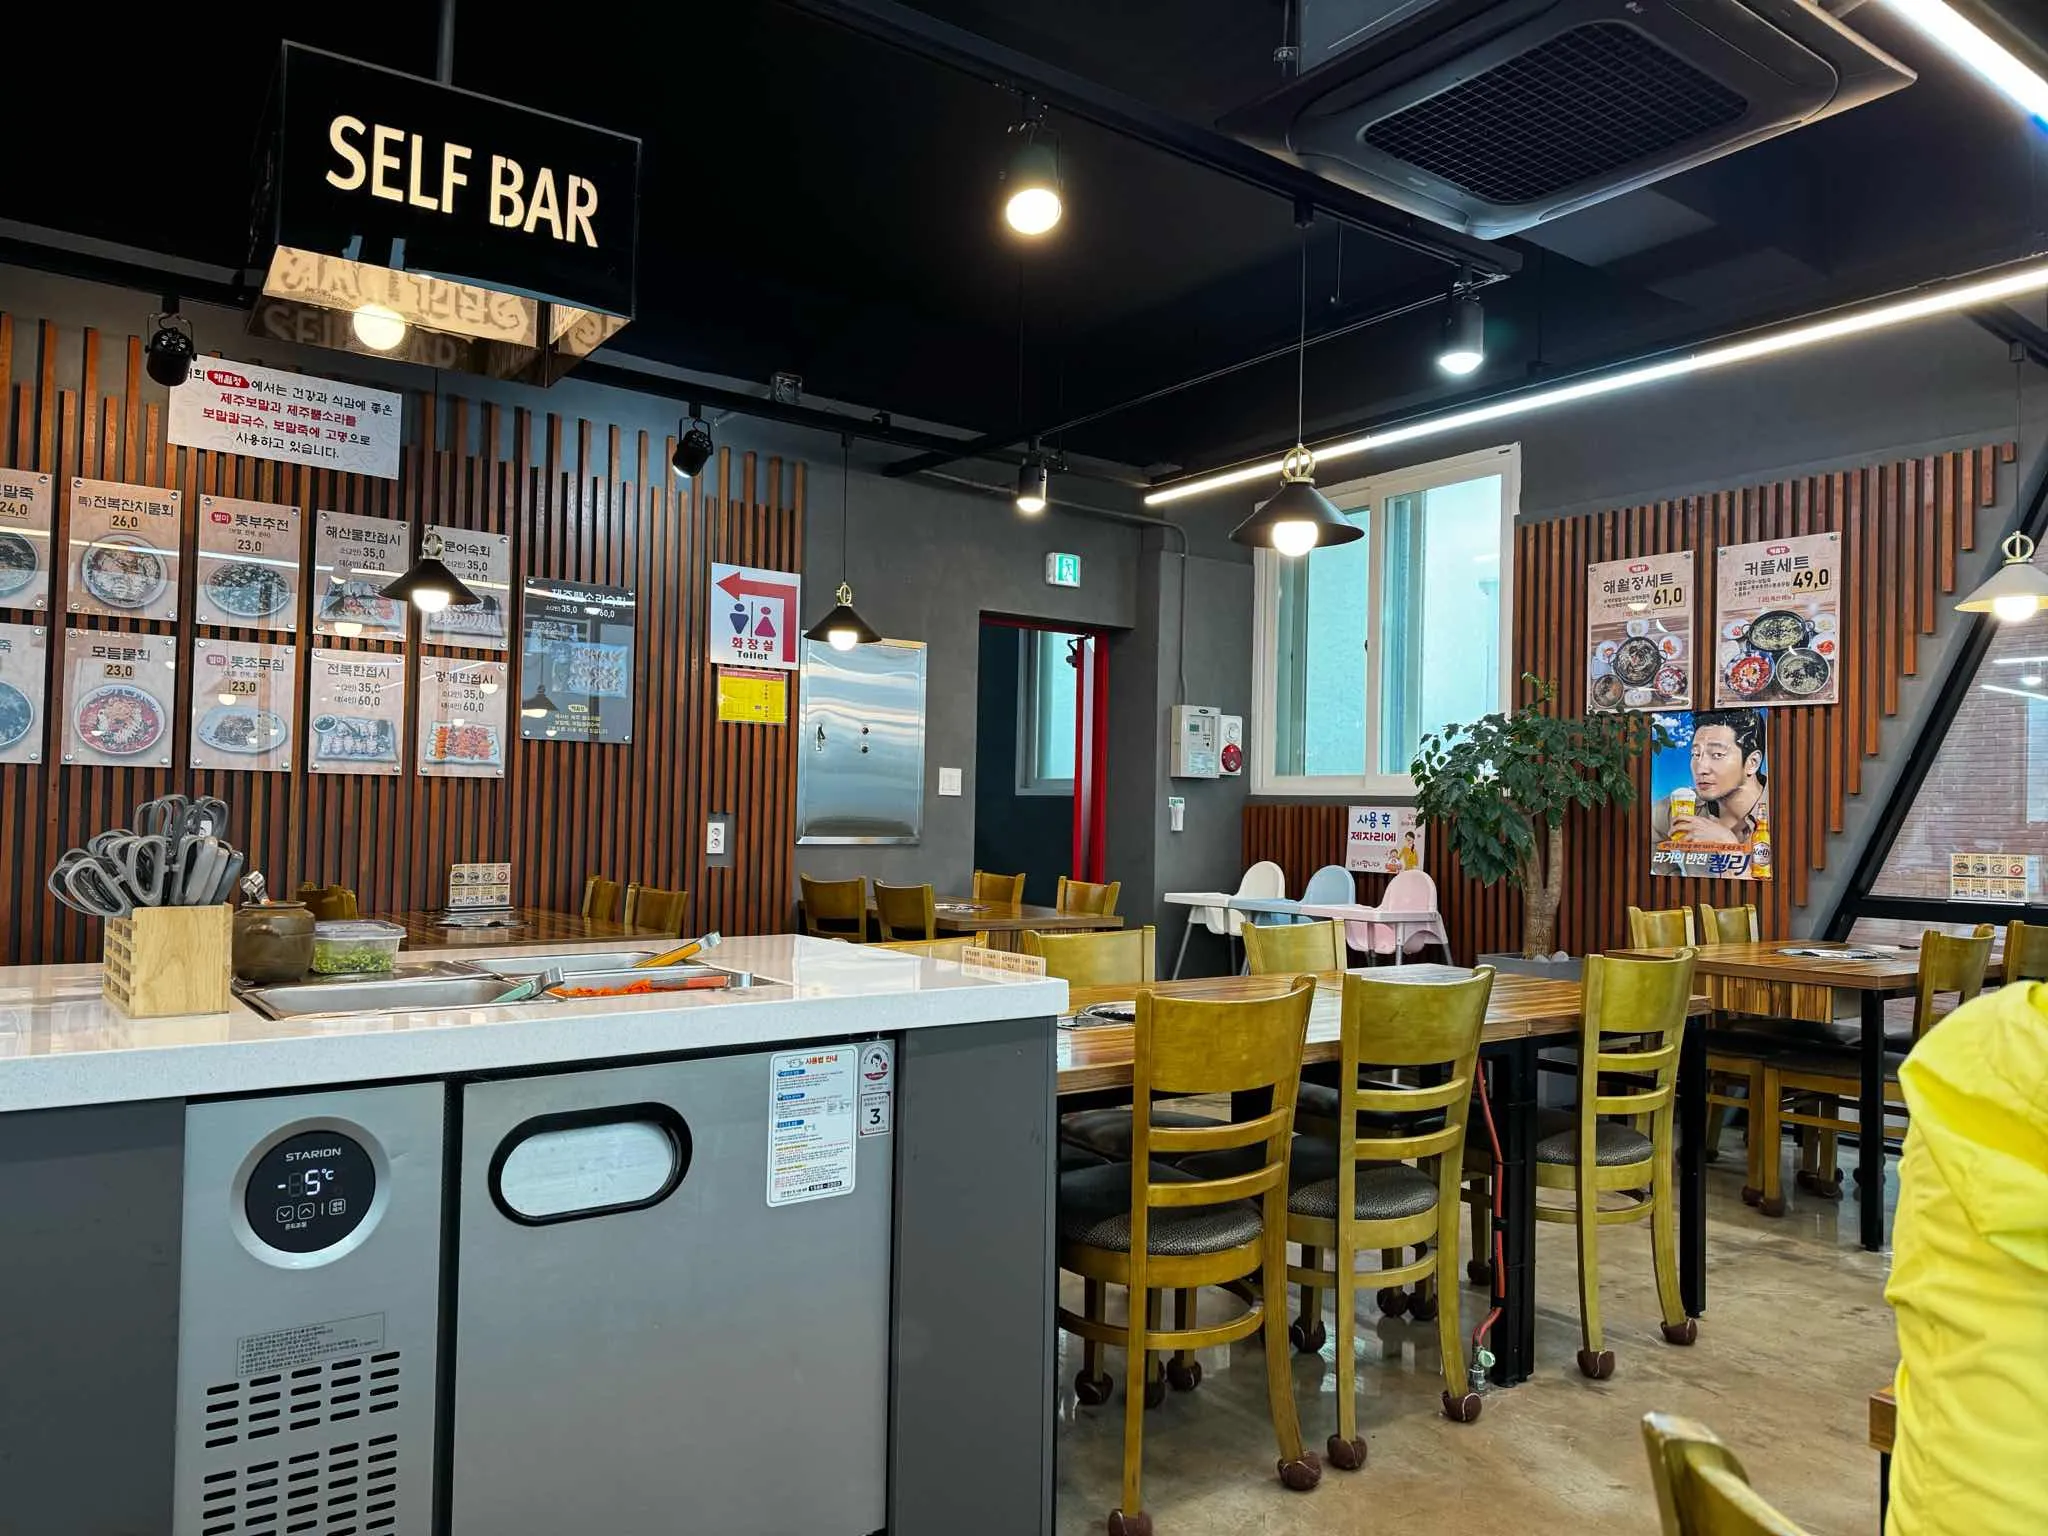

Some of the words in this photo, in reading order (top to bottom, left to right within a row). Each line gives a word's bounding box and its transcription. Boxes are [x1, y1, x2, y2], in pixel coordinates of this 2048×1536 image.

[326, 115, 472, 213] SELF
[489, 154, 599, 248] BAR
[220, 392, 281, 413] 제주보말과
[251, 380, 288, 396] 에서는
[292, 387, 328, 405] 건강과
[332, 395, 366, 411] 식감에
[371, 402, 393, 416] 좋은
[235, 431, 284, 449] 사용하고
[289, 441, 339, 459] 있습니다.
[325, 429, 371, 446] 고명으로
[0, 484, 34, 501] 말죽
[0, 501, 28, 516] 24,0
[112, 515, 138, 528] 26,0
[325, 526, 401, 546] 해산물한접시
[238, 539, 262, 552] 23,0
[363, 547, 385, 559] 35,0
[445, 541, 490, 557] 문어숙회
[467, 560, 488, 571] 35,0
[1744, 556, 1809, 576] 커플세트
[1603, 572, 1674, 594] 해월정세트
[1793, 568, 1829, 589] 49,0
[1653, 587, 1682, 606] 61,0
[561, 604, 578, 614] 35,0
[731, 637, 774, 652] 화장실
[736, 650, 769, 661] Toilet
[106, 664, 132, 678] 23,0
[327, 663, 390, 679] 전복한접시
[232, 681, 256, 693] 23,0
[358, 682, 381, 694] 35,0
[463, 689, 485, 700] 35,0
[358, 695, 380, 707] 60,0
[463, 702, 484, 713] 60,0
[1356, 811, 1378, 829] 사용
[1381, 812, 1391, 828] 후
[1350, 831, 1396, 842] 제자리에
[1653, 851, 1684, 864] 라거의
[1685, 852, 1707, 865] 반전
[1708, 853, 1751, 876] 켈리
[870, 1108, 881, 1125] 3
[285, 1147, 342, 1162] STARION
